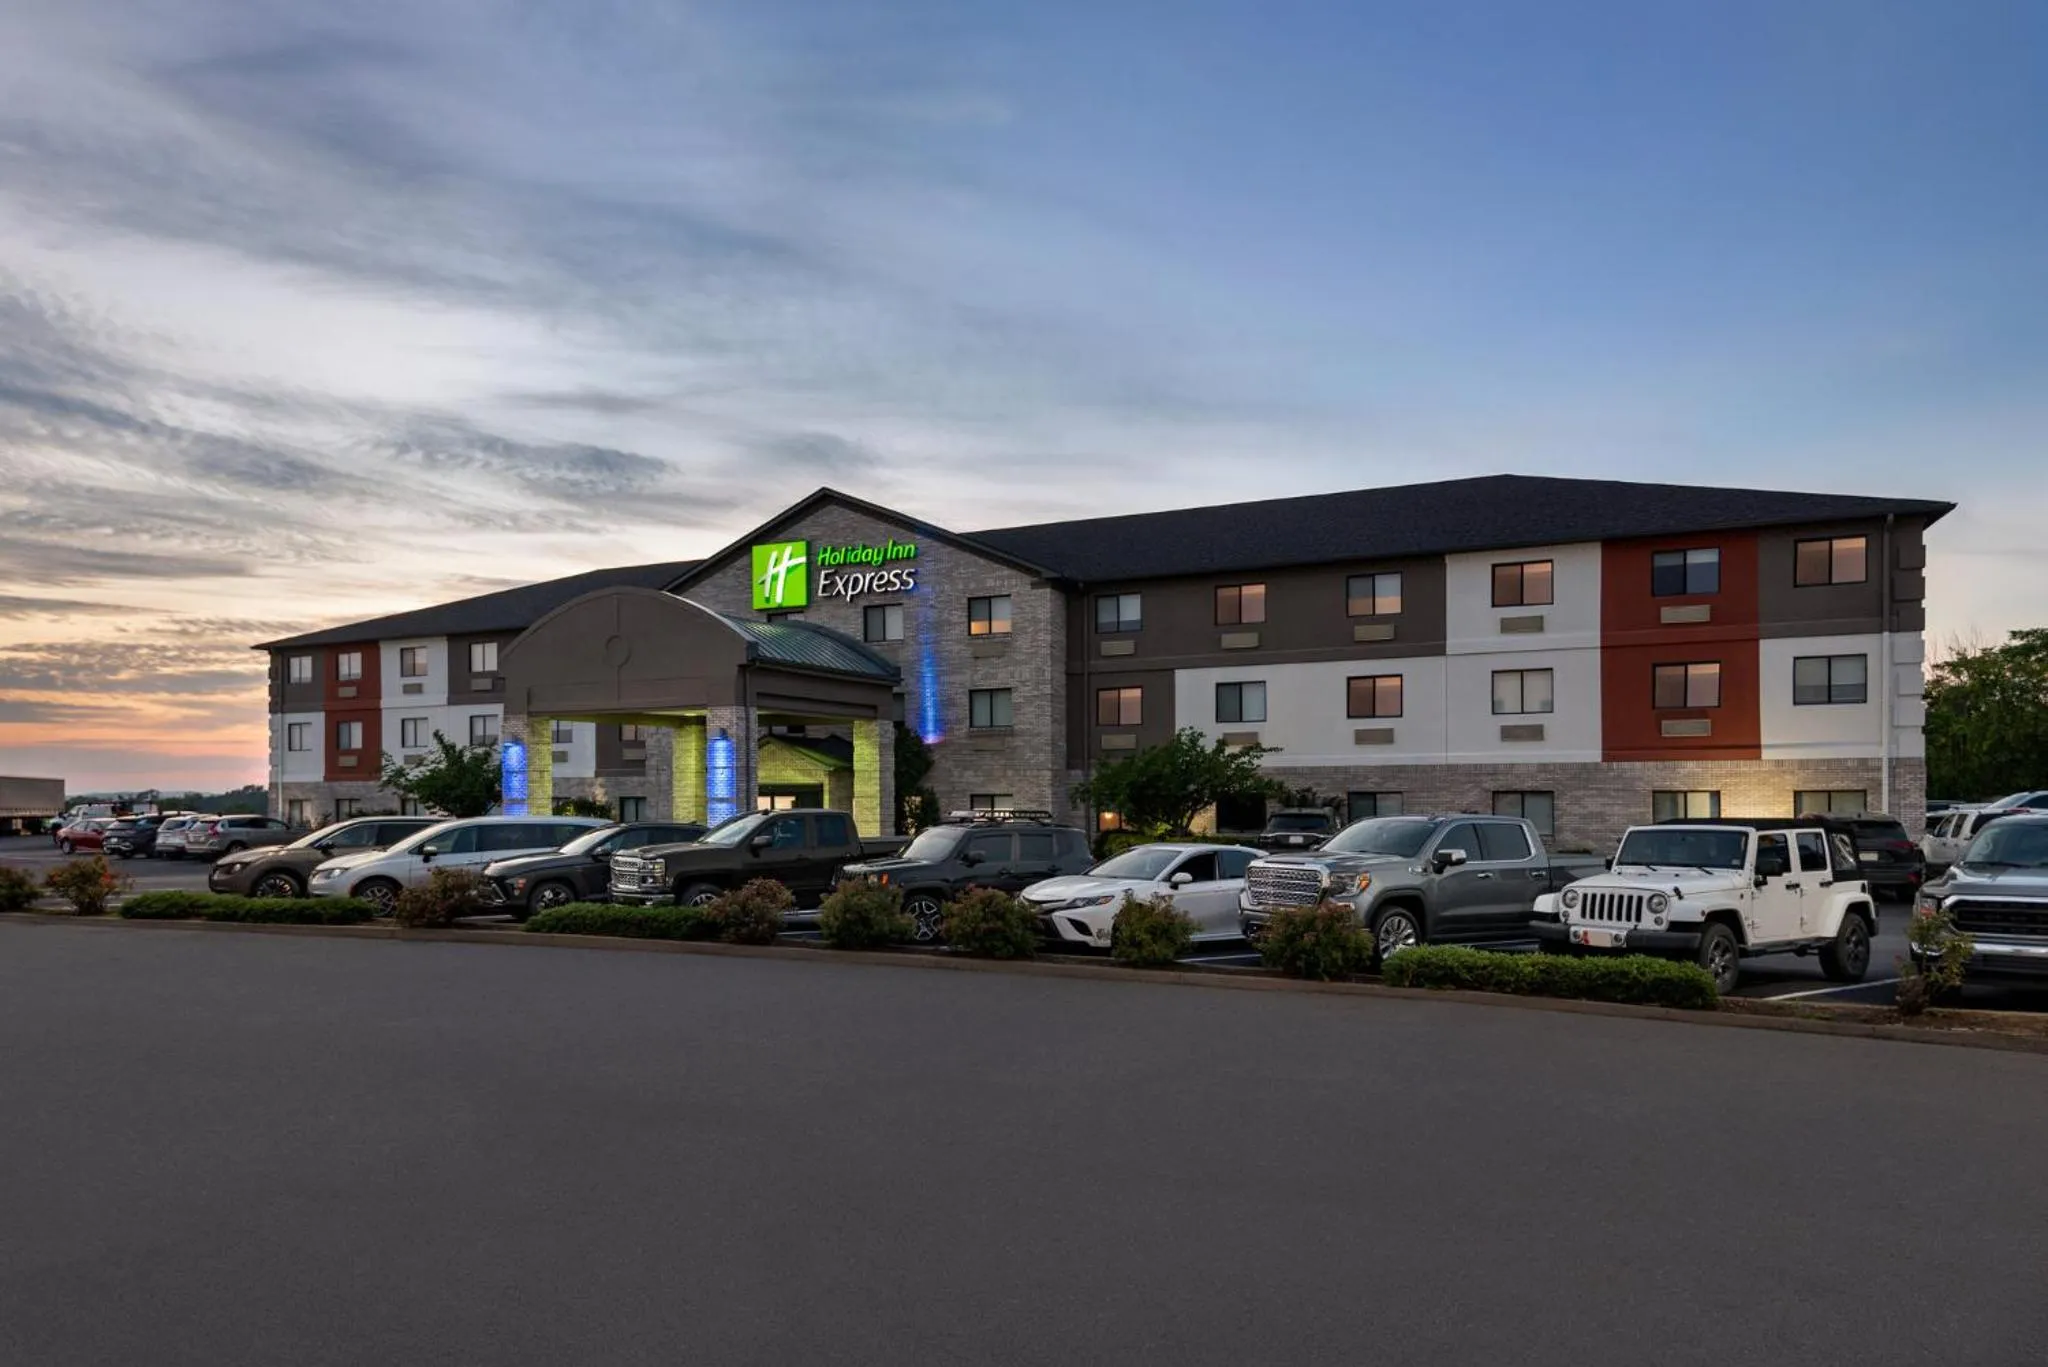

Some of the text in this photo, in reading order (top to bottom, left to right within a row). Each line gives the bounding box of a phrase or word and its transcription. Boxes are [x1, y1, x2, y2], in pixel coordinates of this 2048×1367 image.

[818, 539, 915, 566] Holiday Inn
[818, 568, 915, 602] Express
